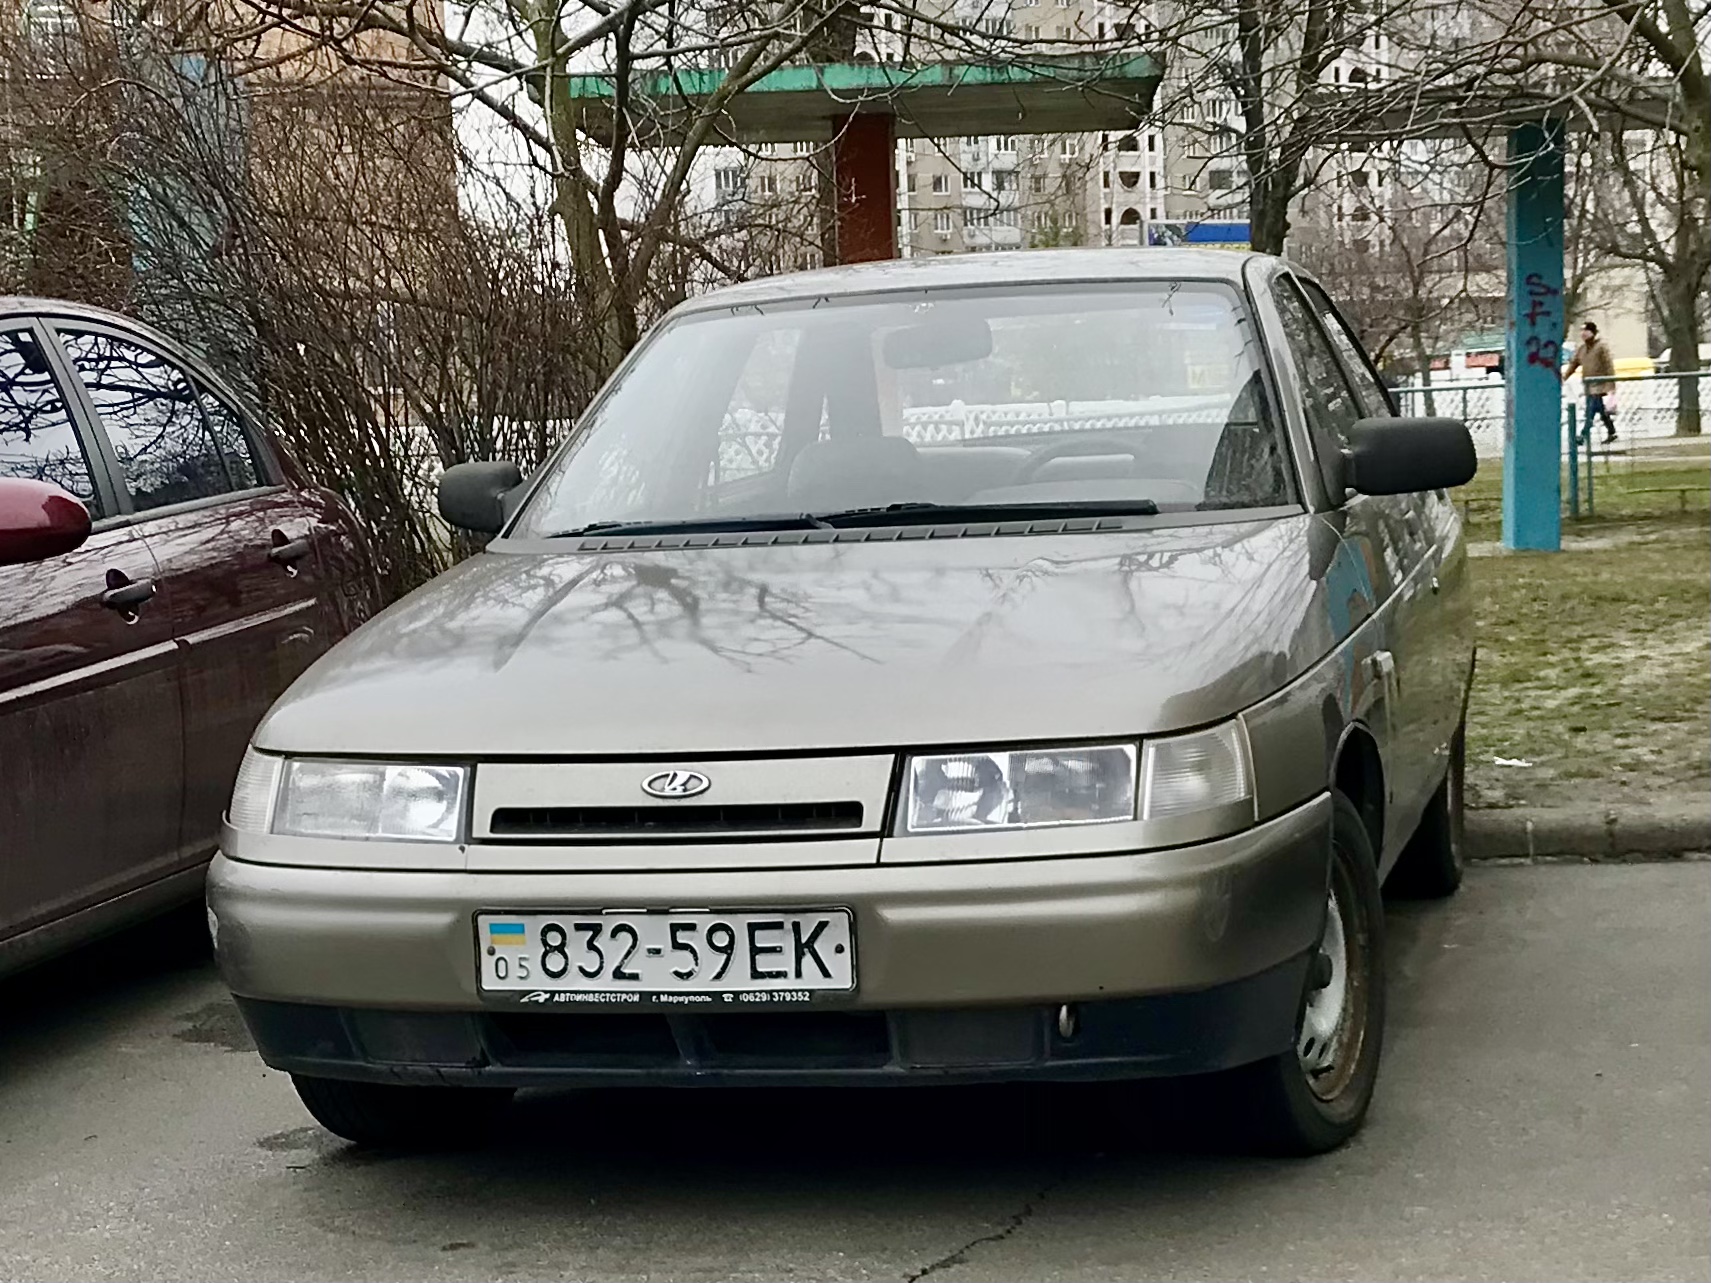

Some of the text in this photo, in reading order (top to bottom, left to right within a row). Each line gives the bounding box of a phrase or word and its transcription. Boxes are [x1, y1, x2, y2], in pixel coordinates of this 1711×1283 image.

[495, 956, 530, 980] 05
[553, 992, 640, 1003] АВТОИНВЕСТСТРОЙ
[660, 993, 712, 1004] Мариуполь
[772, 990, 810, 1002] 379352
